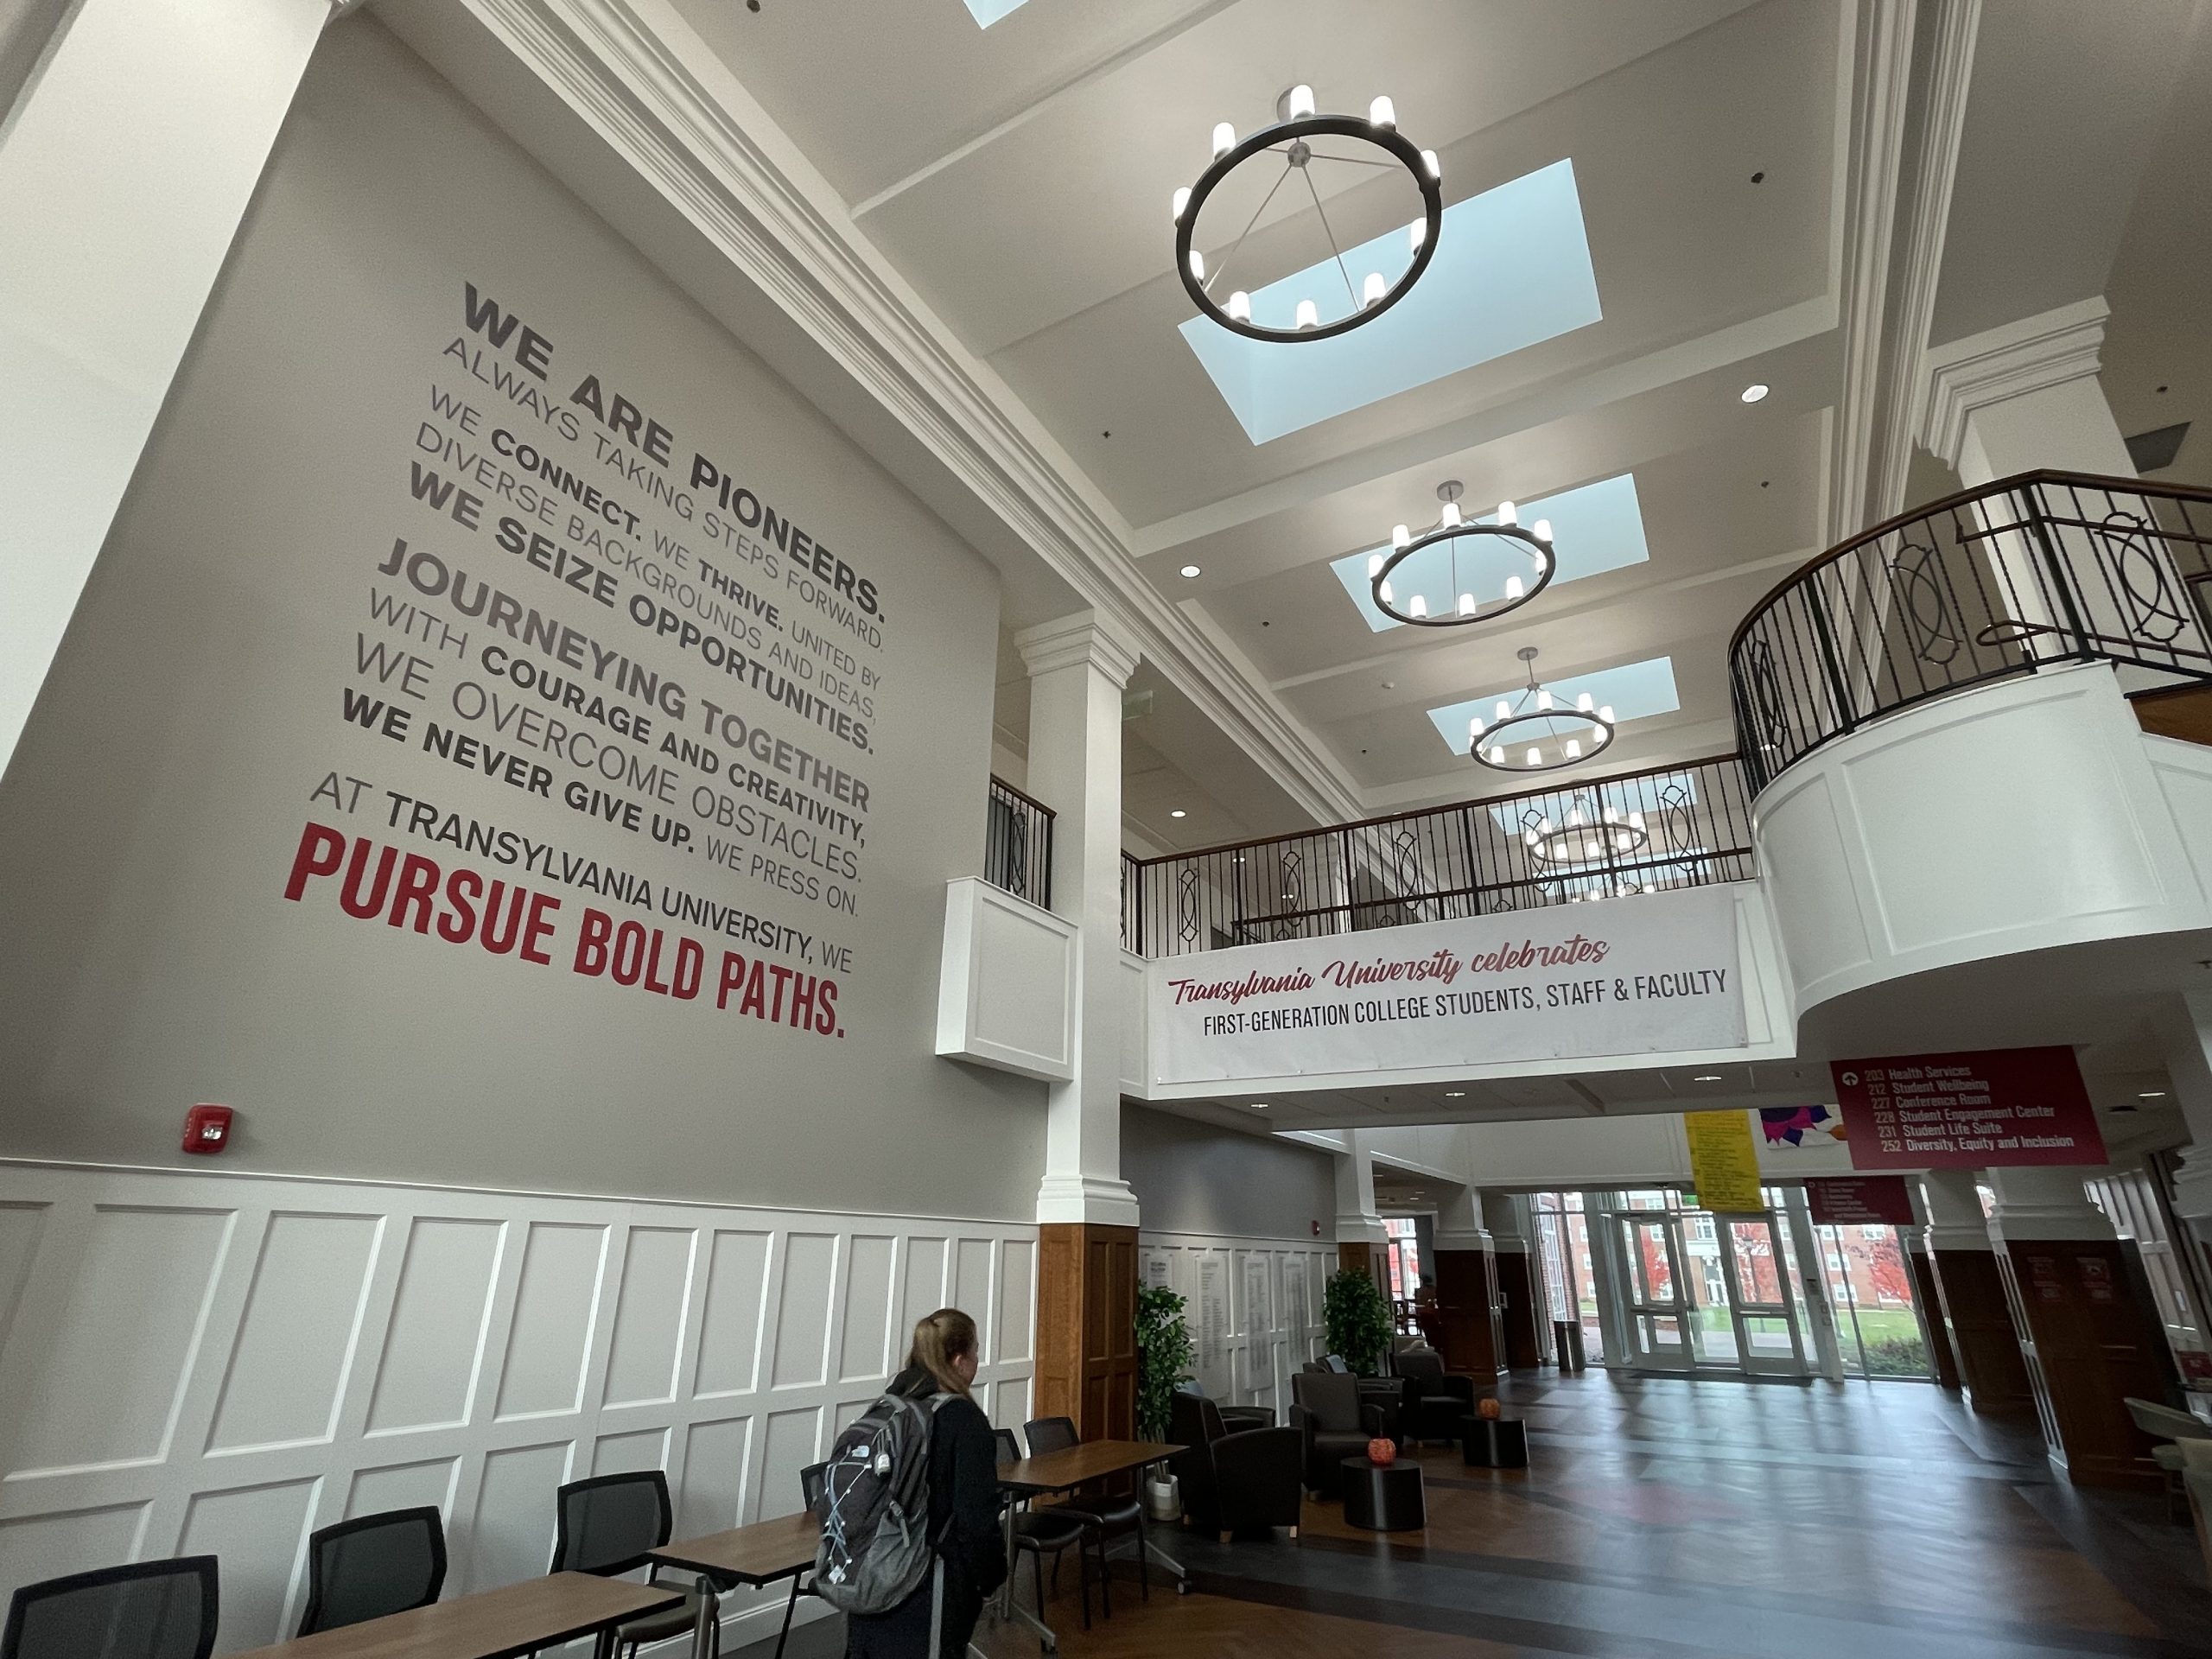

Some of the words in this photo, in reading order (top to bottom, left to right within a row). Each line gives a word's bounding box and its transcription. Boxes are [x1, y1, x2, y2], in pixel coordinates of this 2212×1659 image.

[432, 385, 481, 436] WE
[492, 429, 641, 541] CONNECT.
[654, 530, 690, 570] WE
[698, 558, 784, 632] THRIVE.
[791, 620, 855, 675] UNITED
[861, 666, 880, 691] BY
[442, 337, 580, 442] ALWAYS
[594, 431, 694, 522] TAKING
[702, 512, 779, 579] STEPS
[787, 569, 882, 652] FORWARD.
[465, 281, 554, 381] WE
[569, 374, 673, 468] ARE
[690, 453, 885, 623] PIONEERS.
[378, 537, 686, 721] JOURNEYING
[701, 699, 869, 812] TOGETHER
[411, 461, 484, 531] WE
[495, 517, 618, 608] SEIZE
[629, 594, 874, 755] OPPORTUNITIES.
[416, 422, 558, 526] DIVERSE
[567, 514, 761, 649] BACKGROUNDS
[768, 642, 812, 679] AND
[820, 670, 876, 725] IDEAS,
[344, 688, 411, 742] WE
[423, 722, 553, 798] NEVER
[564, 781, 642, 832] GIVE
[652, 814, 694, 853] UP.
[707, 835, 744, 872] WE
[751, 854, 819, 900] PRESS
[827, 886, 858, 917] ON.
[358, 632, 434, 701] WE
[452, 681, 679, 805] OVERCOME
[692, 785, 861, 882] OBSTACLES.
[372, 587, 468, 658] WITH
[481, 645, 652, 745] COURAGE
[659, 731, 719, 776] AND
[728, 763, 864, 849] CREATIVITY,
[284, 822, 562, 965] PURSUE
[573, 907, 704, 1000] BOLD
[716, 950, 844, 1038] PATHS.
[309, 772, 372, 813] AT
[386, 791, 652, 911] TRANSYLVANIA
[662, 887, 813, 964] UNIVERSITY,
[822, 941, 853, 973] WE
[1168, 967, 1315, 1005] Transylvania
[1321, 949, 1463, 988] University
[1471, 934, 1610, 973] celebrates
[1205, 1005, 1350, 1036] FIRST-GENERATION
[1355, 996, 1430, 1023] COLLEGE
[1435, 987, 1541, 1016] STUDENTS,
[1547, 980, 1605, 1007] STAFF
[1614, 978, 1629, 1001] &
[1635, 969, 1726, 999] FACULTY
[1868, 1083, 1887, 1096] 212
[1891, 1081, 1935, 1094] Student
[1936, 1078, 1989, 1092] Wellbeing
[1872, 1096, 1891, 1109] 227
[1896, 1096, 1957, 1108] Conference
[1959, 1093, 1991, 1105] Room
[1888, 1067, 1923, 1080] Health
[1925, 1065, 1972, 1078] Services
[1878, 1125, 1897, 1138] 231
[1903, 1123, 1946, 1137] Student
[1948, 1122, 1970, 1135] Life
[1973, 1122, 2003, 1134] Suite
[1881, 1140, 1902, 1153] 252
[1958, 1136, 1994, 1151] Equity
[1997, 1135, 2018, 1150] and
[2021, 1135, 2074, 1147] Inclusion
[1899, 1109, 1942, 1122] Student
[1944, 1107, 2014, 1122] Engagement
[2016, 1105, 2055, 1117] Center
